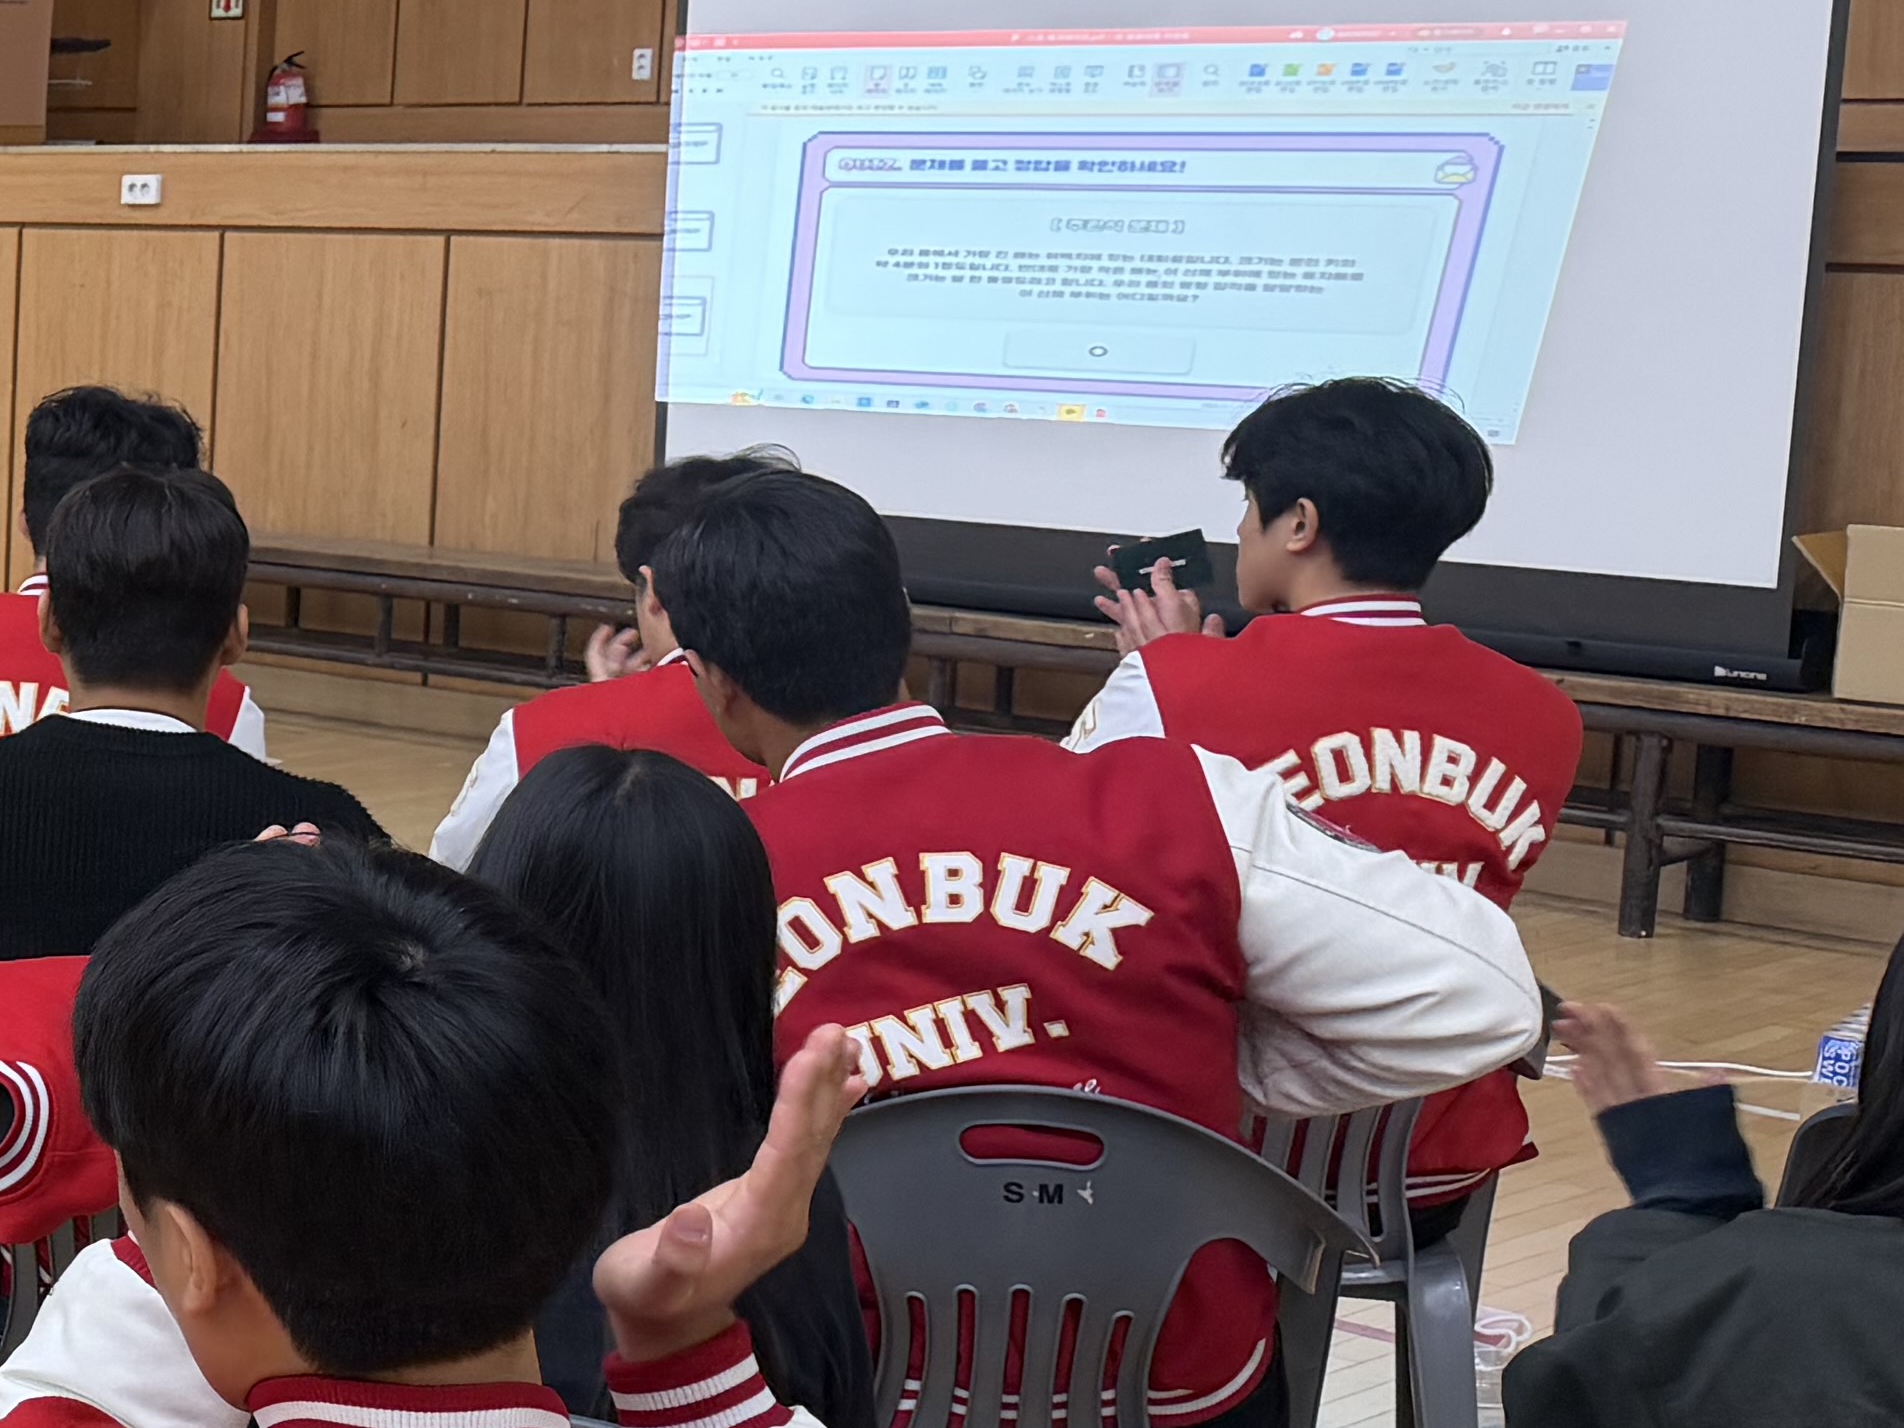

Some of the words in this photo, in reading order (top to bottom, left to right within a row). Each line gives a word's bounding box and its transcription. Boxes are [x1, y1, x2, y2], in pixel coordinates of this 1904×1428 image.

[910, 159, 965, 172] 문제를
[971, 159, 1008, 172] 풀고
[1014, 159, 1071, 172] 정답을
[1077, 160, 1186, 173] 확인하세요!
